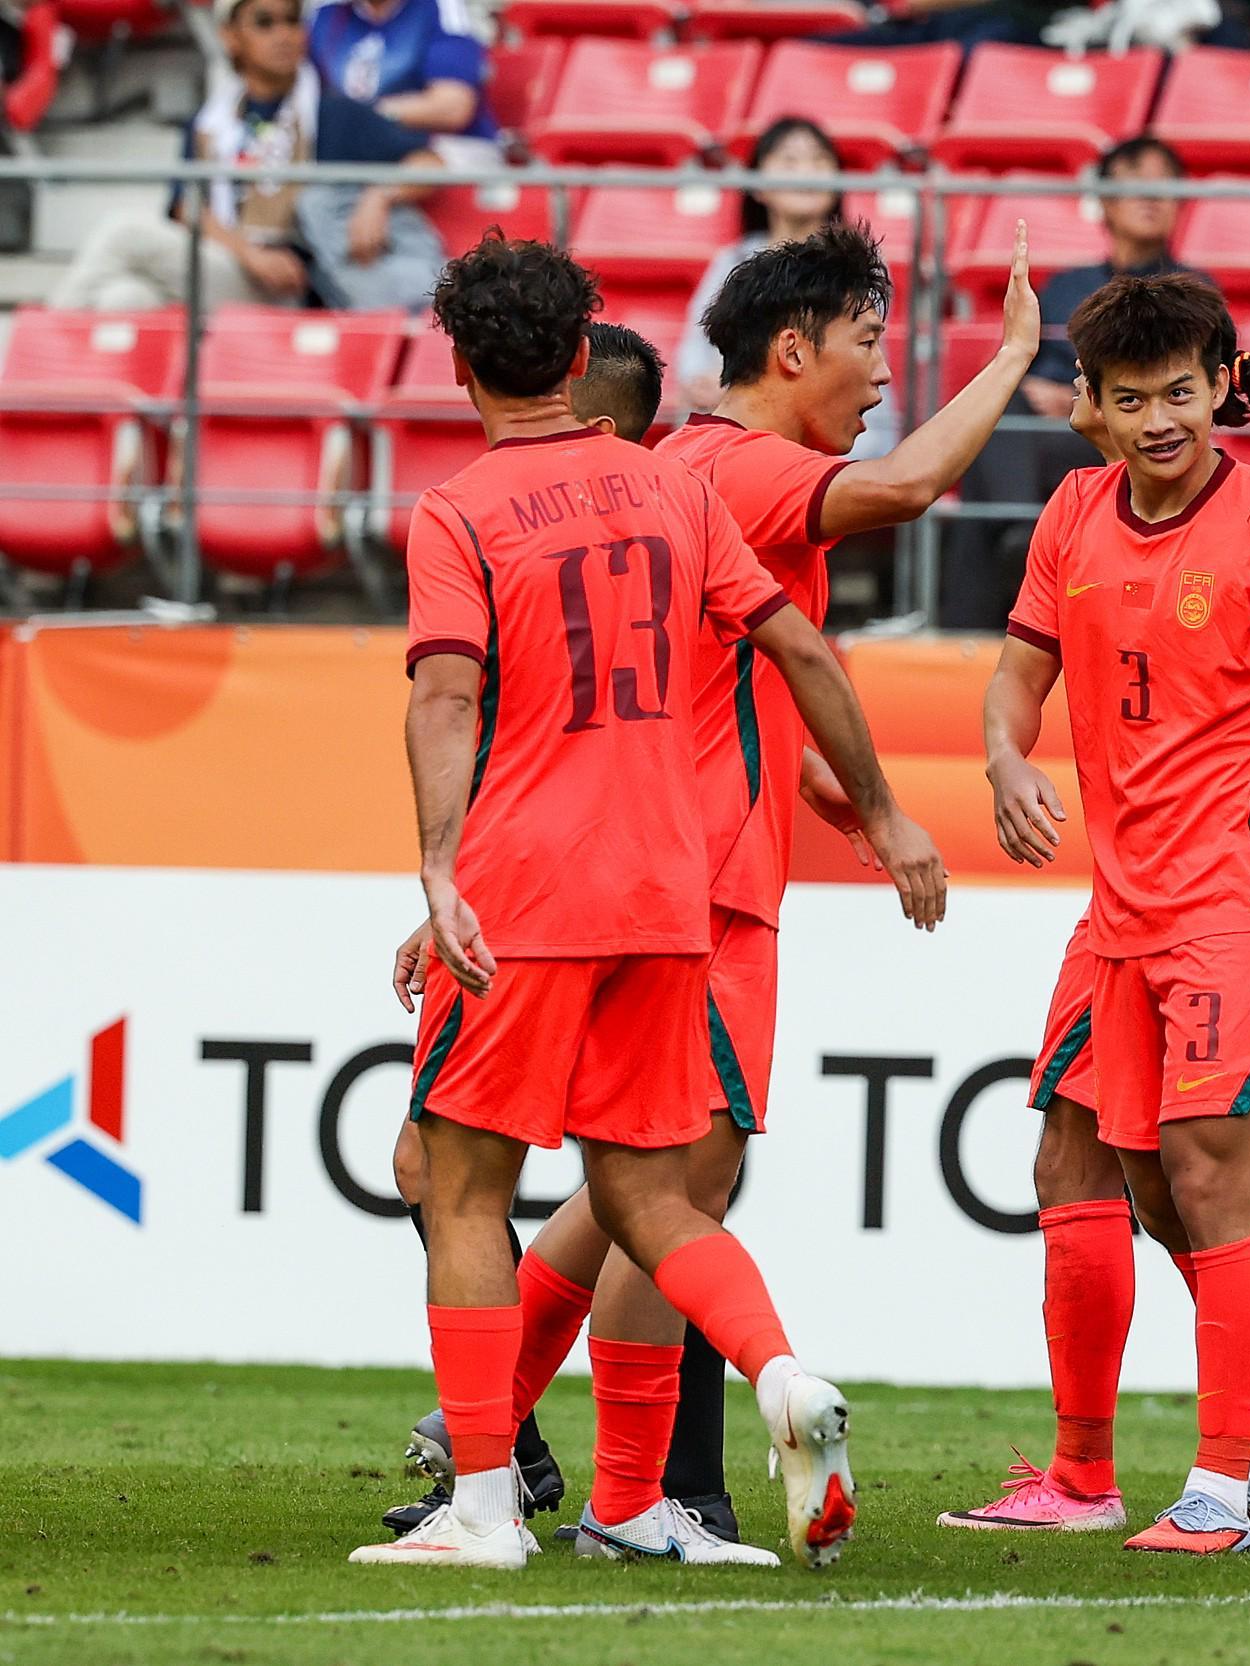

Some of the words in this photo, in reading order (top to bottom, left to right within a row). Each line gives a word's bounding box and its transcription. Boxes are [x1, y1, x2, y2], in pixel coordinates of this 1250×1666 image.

[1183, 574, 1212, 587] CFA
[541, 536, 673, 734] 13
[1116, 649, 1155, 723] 3
[1185, 992, 1223, 1062] 3
